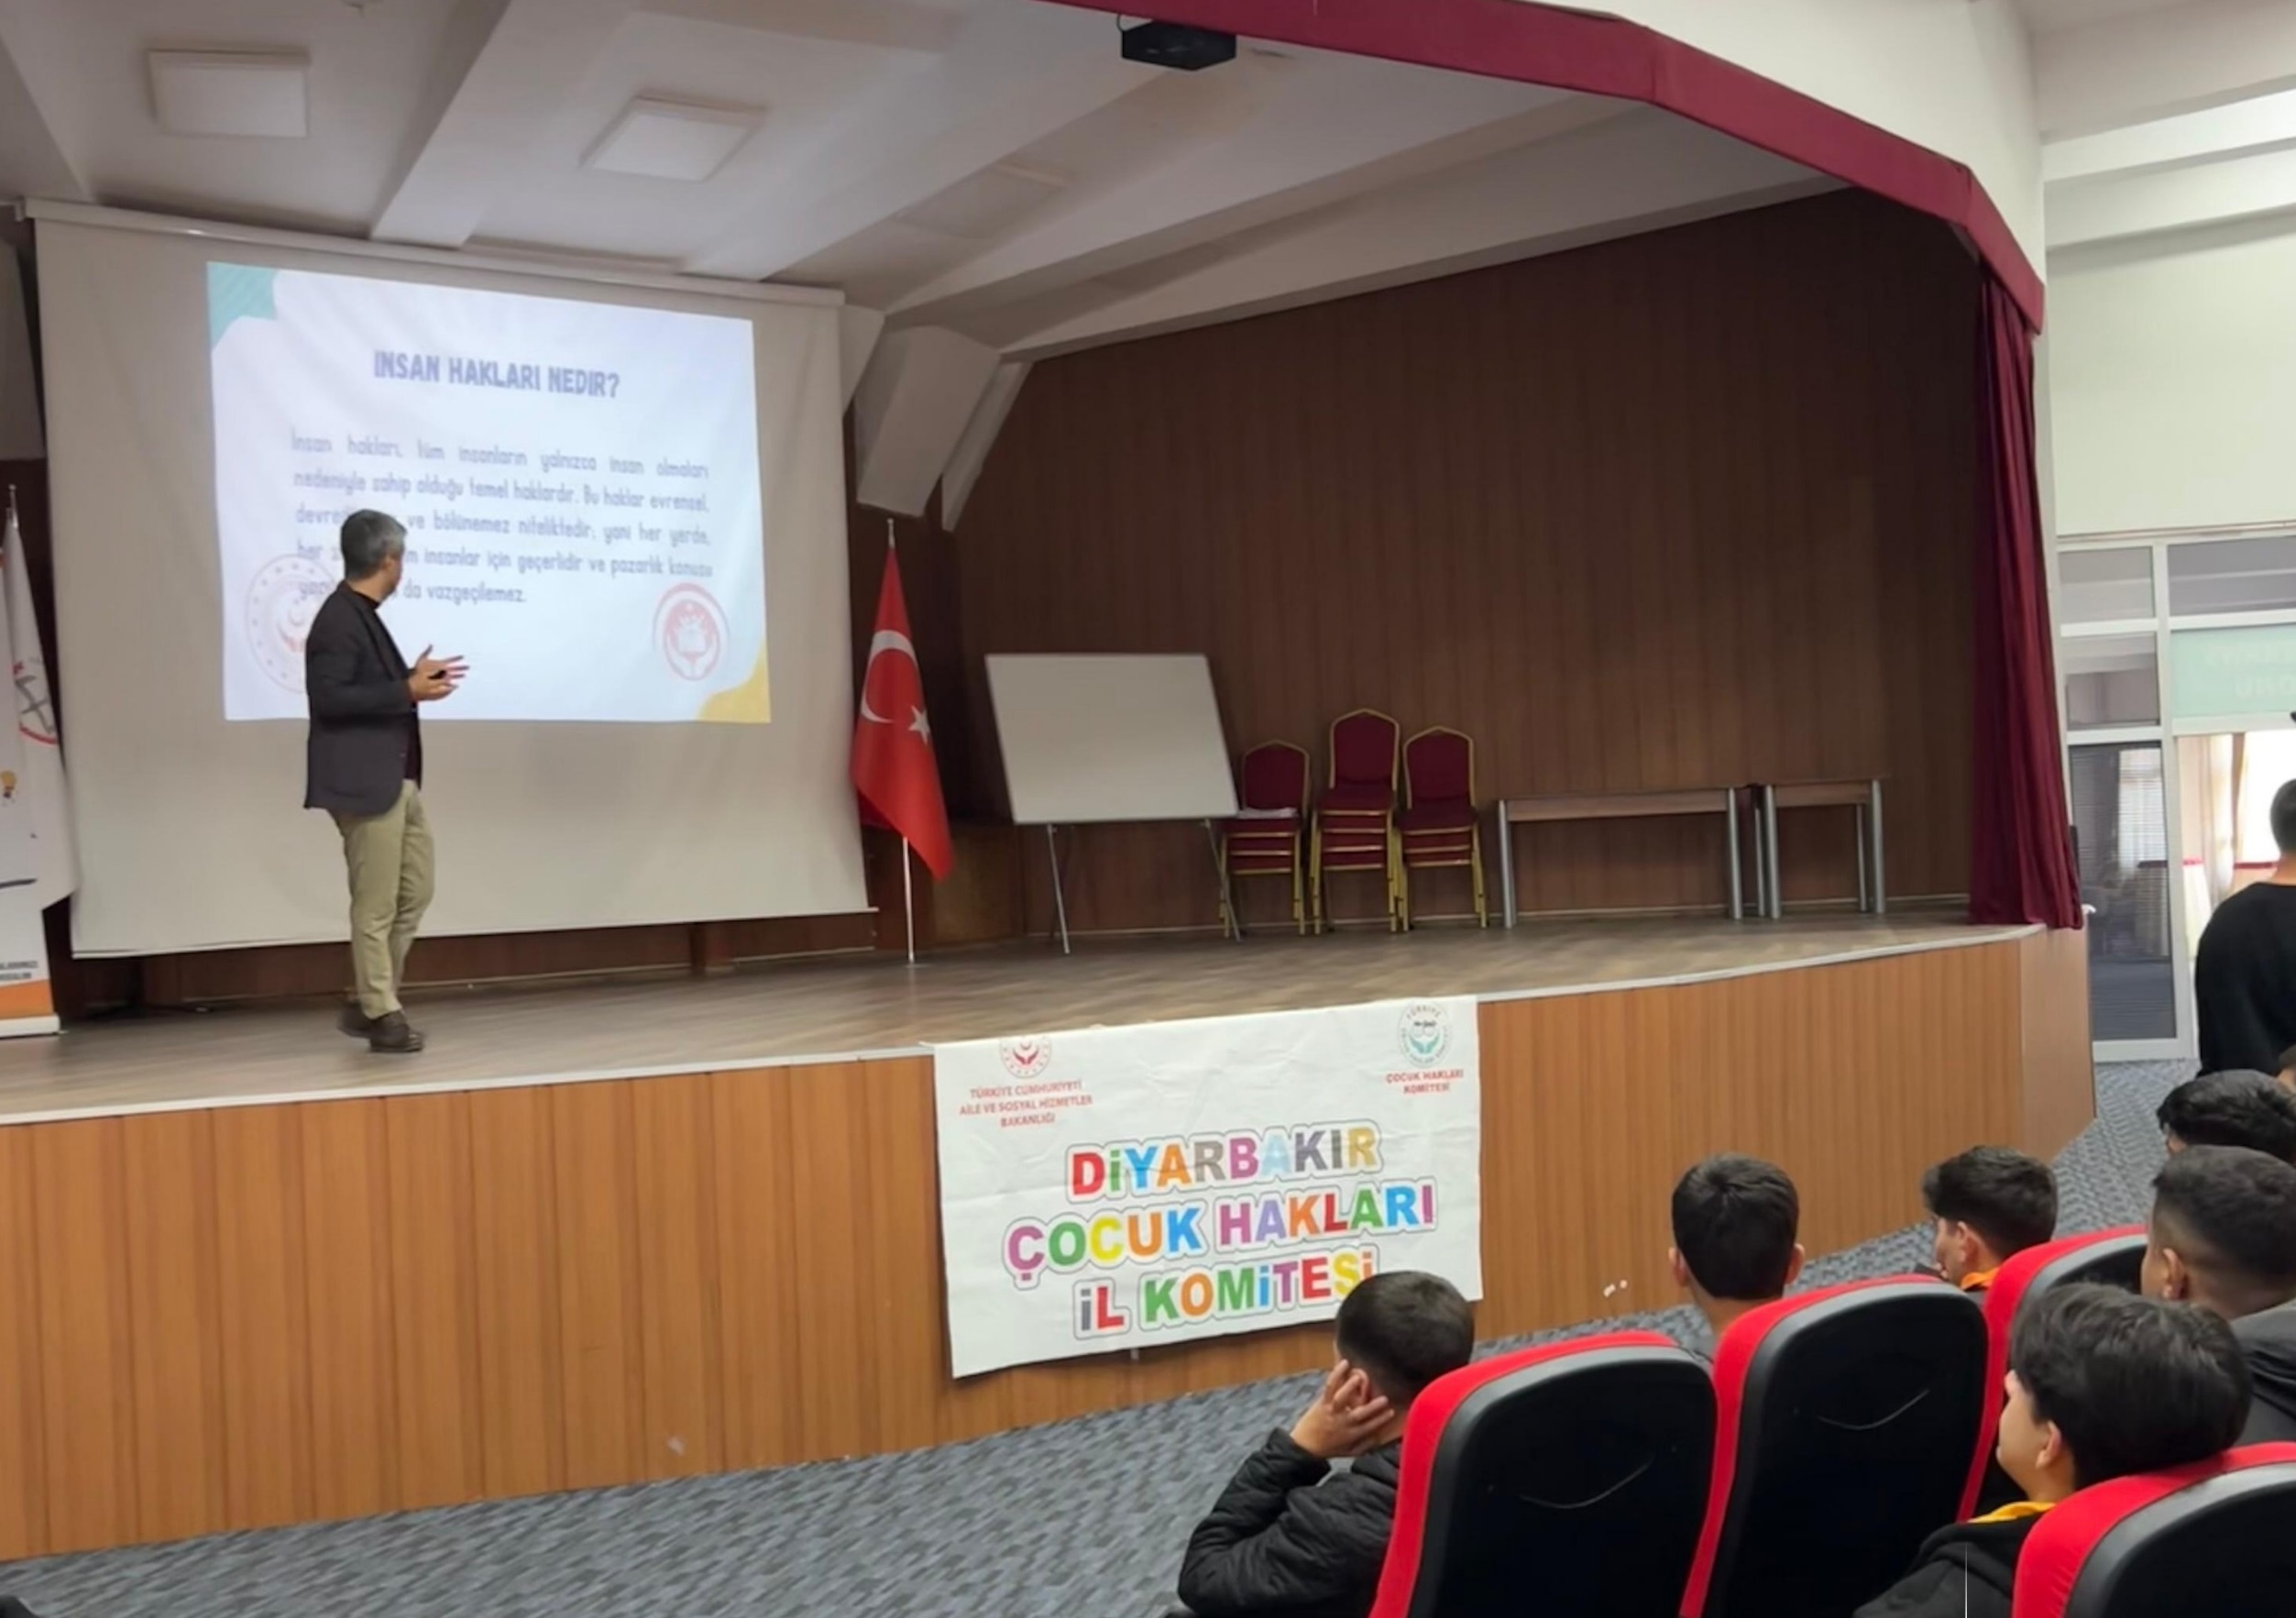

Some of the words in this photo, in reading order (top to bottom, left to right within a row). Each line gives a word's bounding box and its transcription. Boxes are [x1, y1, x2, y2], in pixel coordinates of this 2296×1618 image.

[448, 357, 539, 391] HAKLARI
[541, 449, 597, 472] yalnızca
[610, 456, 644, 474] insan
[656, 457, 709, 478] olmaları
[293, 469, 366, 495] nedeniyle
[372, 472, 411, 498] sahip
[417, 474, 463, 500] olduğu
[469, 478, 509, 499] temel
[583, 484, 599, 505] Bu
[604, 487, 644, 507] haklar
[408, 515, 424, 529] ve
[434, 510, 510, 534] bölünemez
[603, 524, 632, 545] yani
[640, 522, 662, 541] her
[424, 546, 481, 567] insanlar
[488, 549, 511, 571] için
[518, 551, 583, 574] geçerlidir
[588, 557, 606, 572] ve
[610, 555, 665, 579] pazarlık
[668, 556, 713, 578] konusu
[403, 578, 423, 599] da
[1385, 1072, 1421, 1084] ÇOCUK
[1423, 1069, 1464, 1080] HAKLARI
[1403, 1082, 1450, 1094] KOMİTESİ
[970, 1085, 1013, 1099] TÜRKİYE
[960, 1103, 981, 1116] AİLE
[983, 1103, 995, 1114] VE
[998, 1100, 1037, 1112] SOSYAL
[1039, 1094, 1093, 1108] HİZMETLER
[1000, 1111, 1056, 1128] BAKANLIĞI
[1008, 1206, 1202, 1282] ÇOCUK
[1220, 1184, 1434, 1246] HAKLARI
